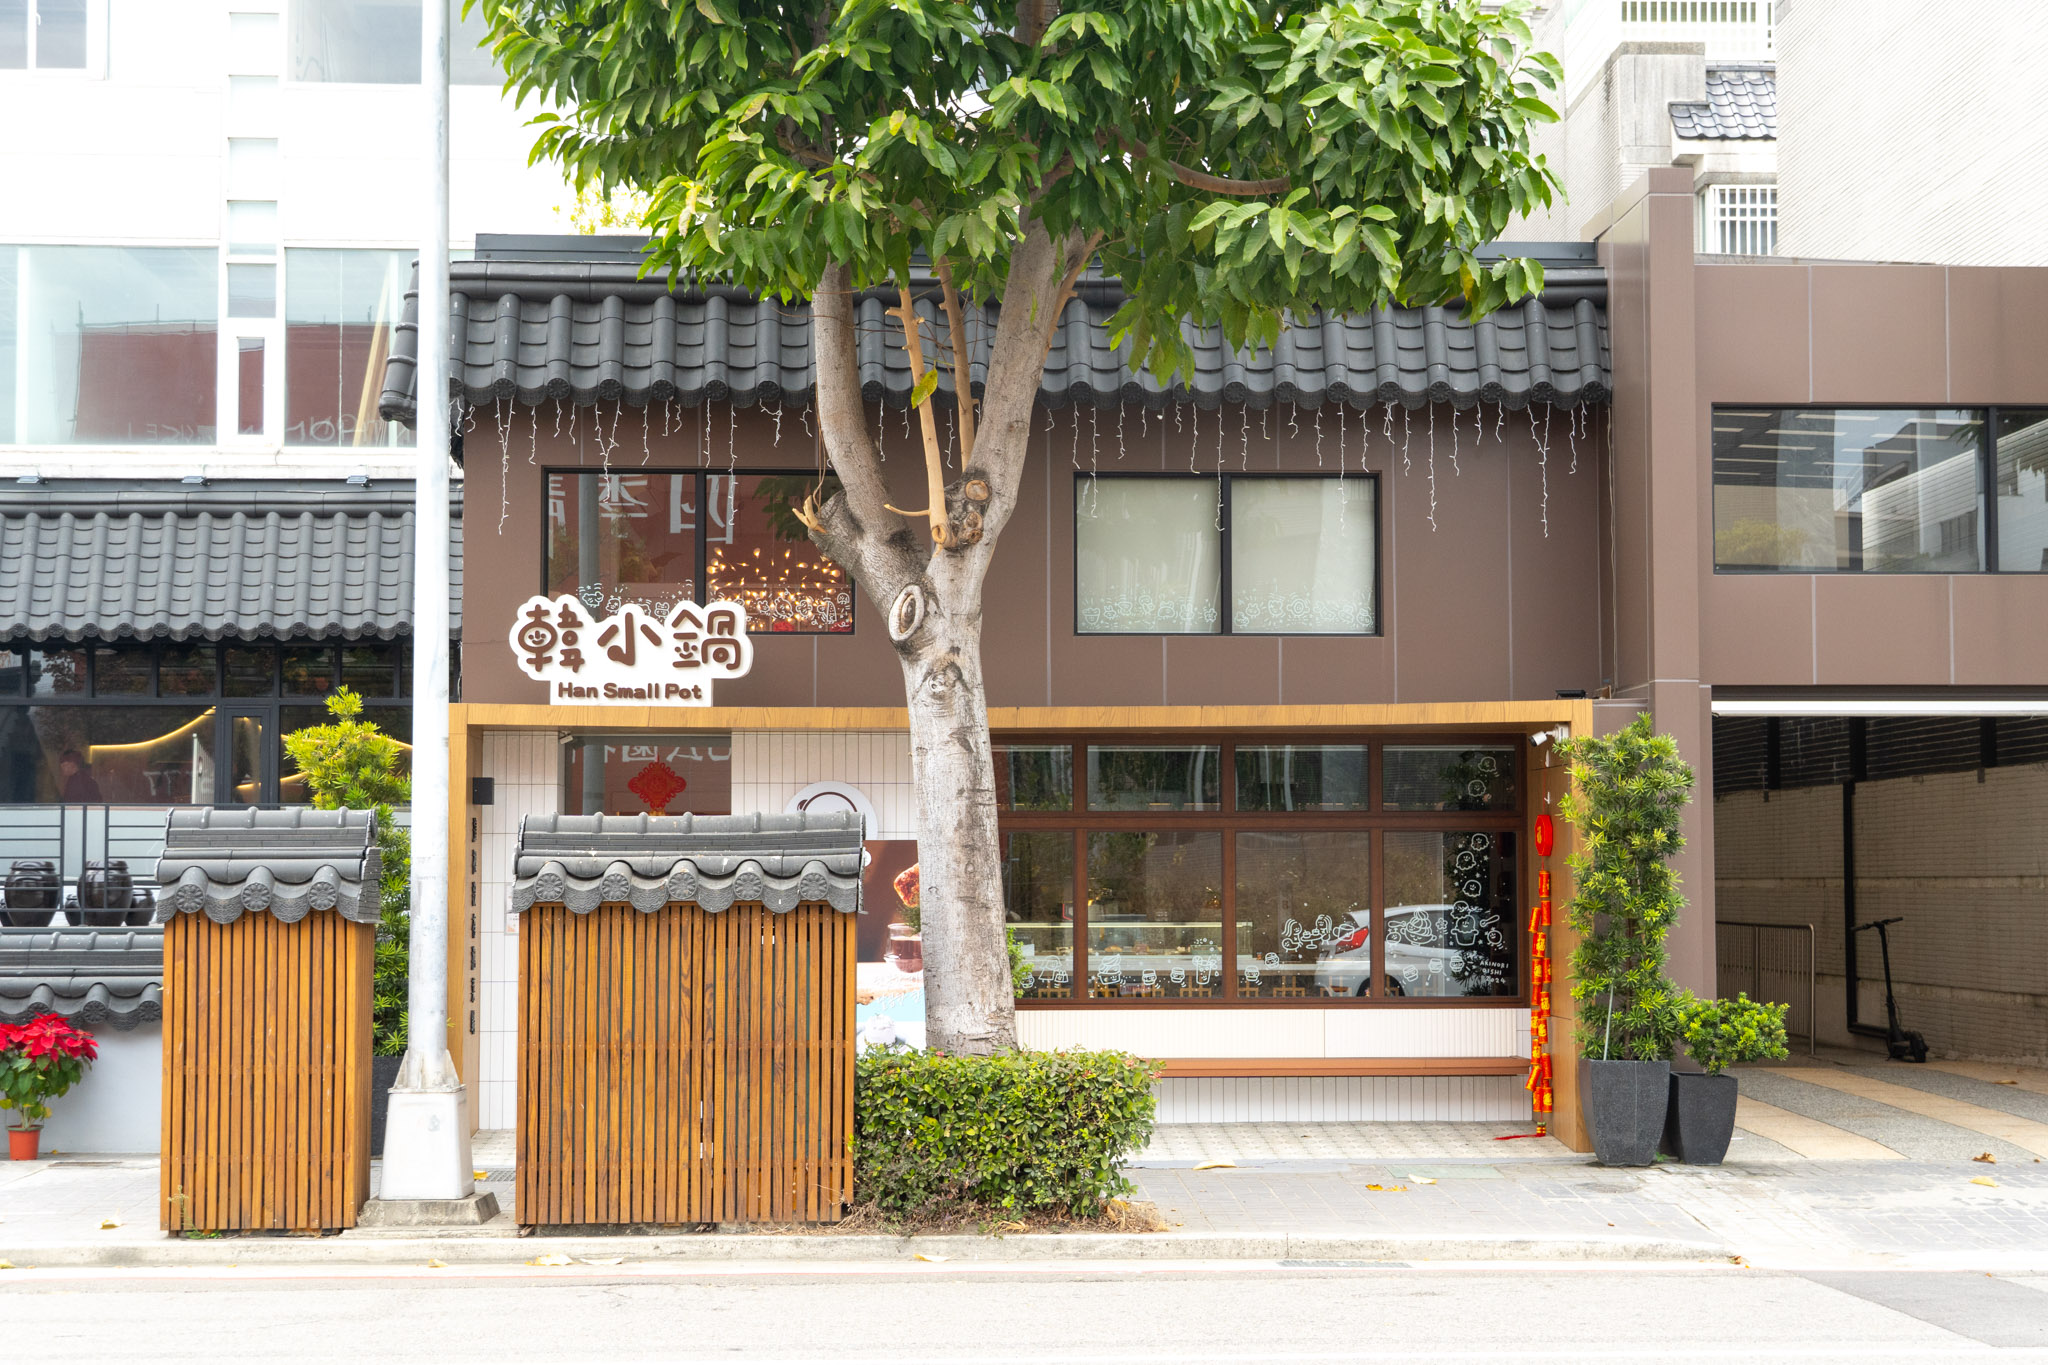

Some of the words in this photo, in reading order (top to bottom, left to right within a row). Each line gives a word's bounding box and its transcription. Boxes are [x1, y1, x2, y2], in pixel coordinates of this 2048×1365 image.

[517, 603, 742, 673] 韓小鍋
[558, 682, 598, 698] Han
[603, 682, 660, 699] Small
[664, 683, 703, 699] Pot
